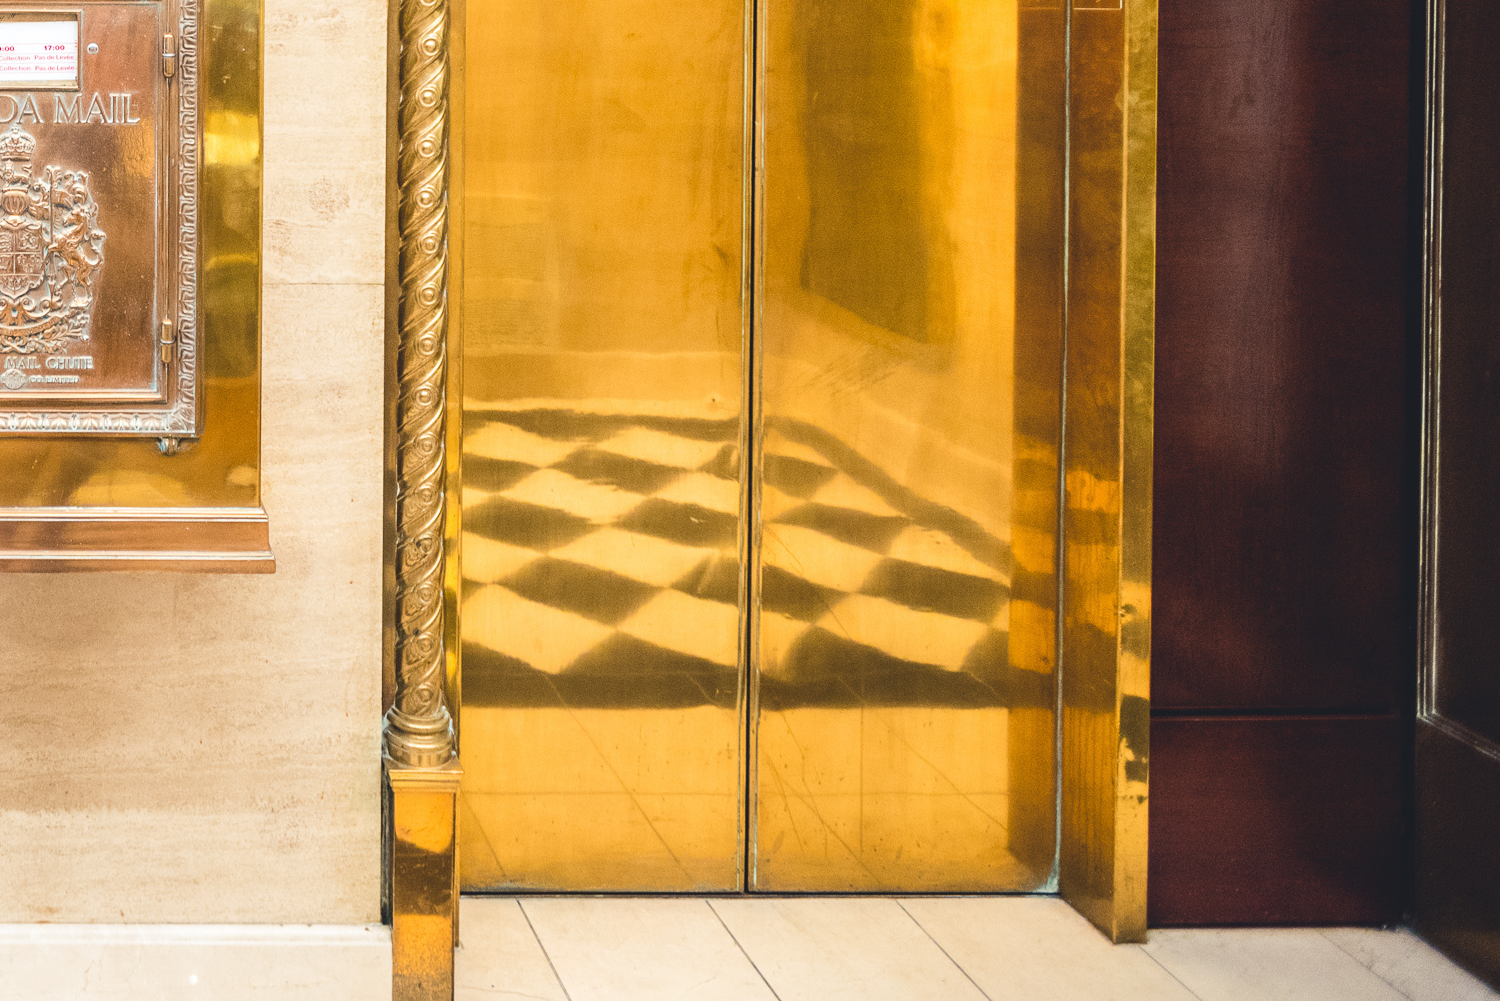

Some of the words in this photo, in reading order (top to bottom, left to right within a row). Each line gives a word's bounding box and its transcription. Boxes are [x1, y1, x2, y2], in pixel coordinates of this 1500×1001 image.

[53, 91, 140, 124] MAIL
[4, 355, 41, 369] MAIL
[45, 355, 94, 370] CHUTE
